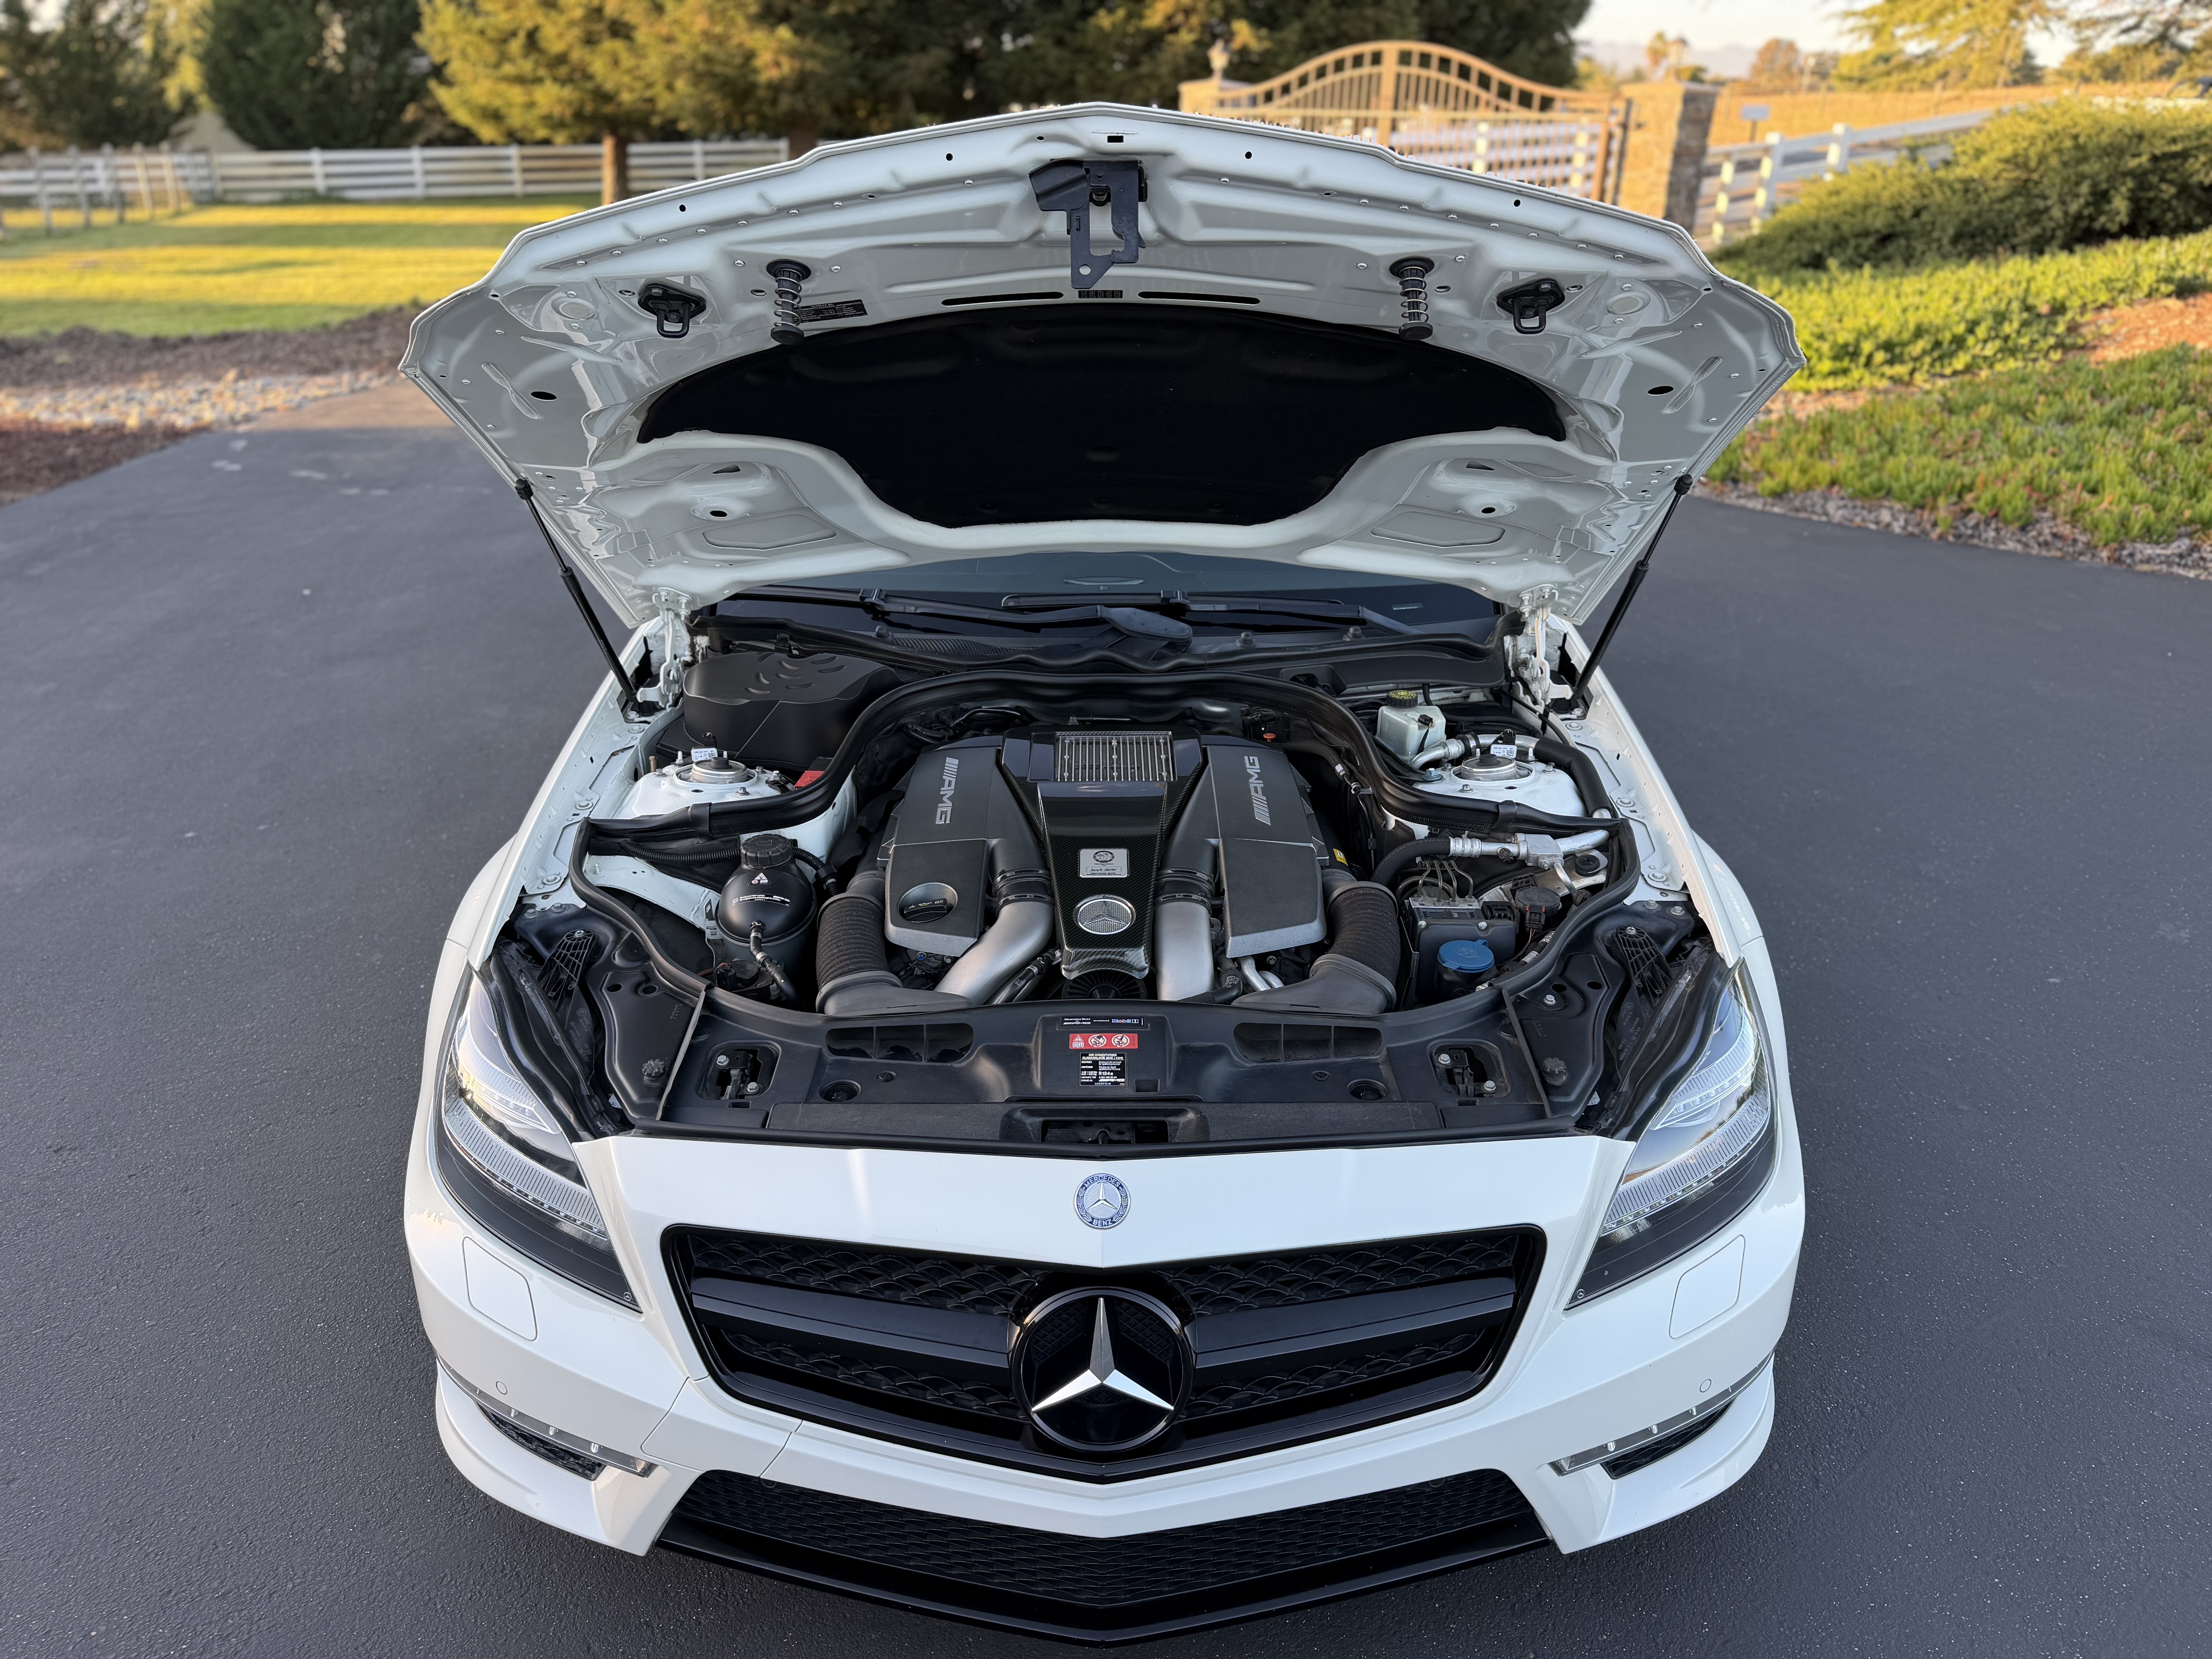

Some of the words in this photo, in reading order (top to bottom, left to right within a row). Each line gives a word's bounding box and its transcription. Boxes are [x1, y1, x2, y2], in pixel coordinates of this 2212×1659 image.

[936, 775, 957, 824] AMG
[1244, 756, 1266, 801] AMG
[1084, 1175, 1120, 1188] MERCEDES
